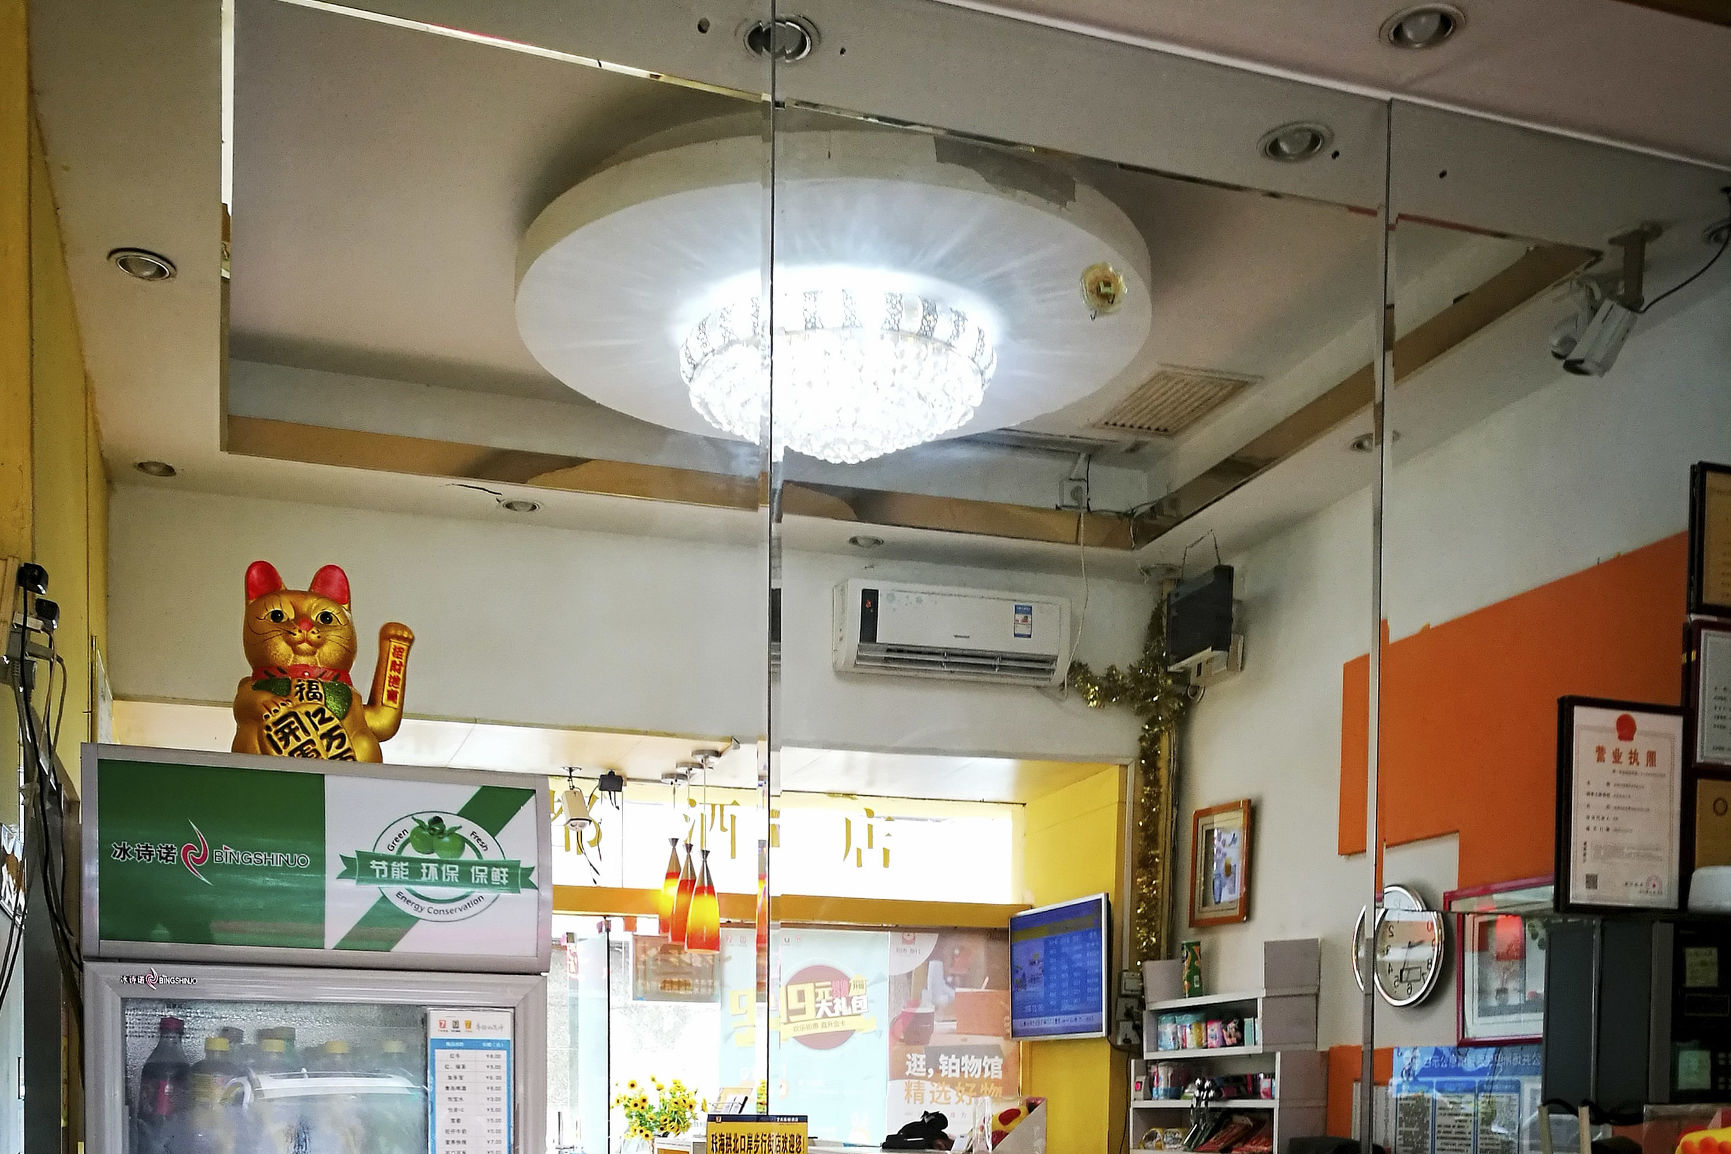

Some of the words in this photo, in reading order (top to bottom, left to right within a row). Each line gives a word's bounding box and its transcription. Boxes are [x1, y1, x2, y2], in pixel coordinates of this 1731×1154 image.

[294, 678, 325, 704] 福
[1595, 744, 1657, 768] 营业执照
[386, 828, 410, 852] Green
[469, 830, 489, 852] Fresh
[111, 841, 178, 865] 冰诗诺
[370, 859, 410, 880] 节能
[420, 862, 460, 883] 环保
[470, 865, 510, 886] 保鲜
[395, 890, 426, 914] Energy
[427, 894, 485, 916] Conservation
[815, 994, 868, 1019] 大礼包
[905, 1080, 1003, 1105] 精选好物
